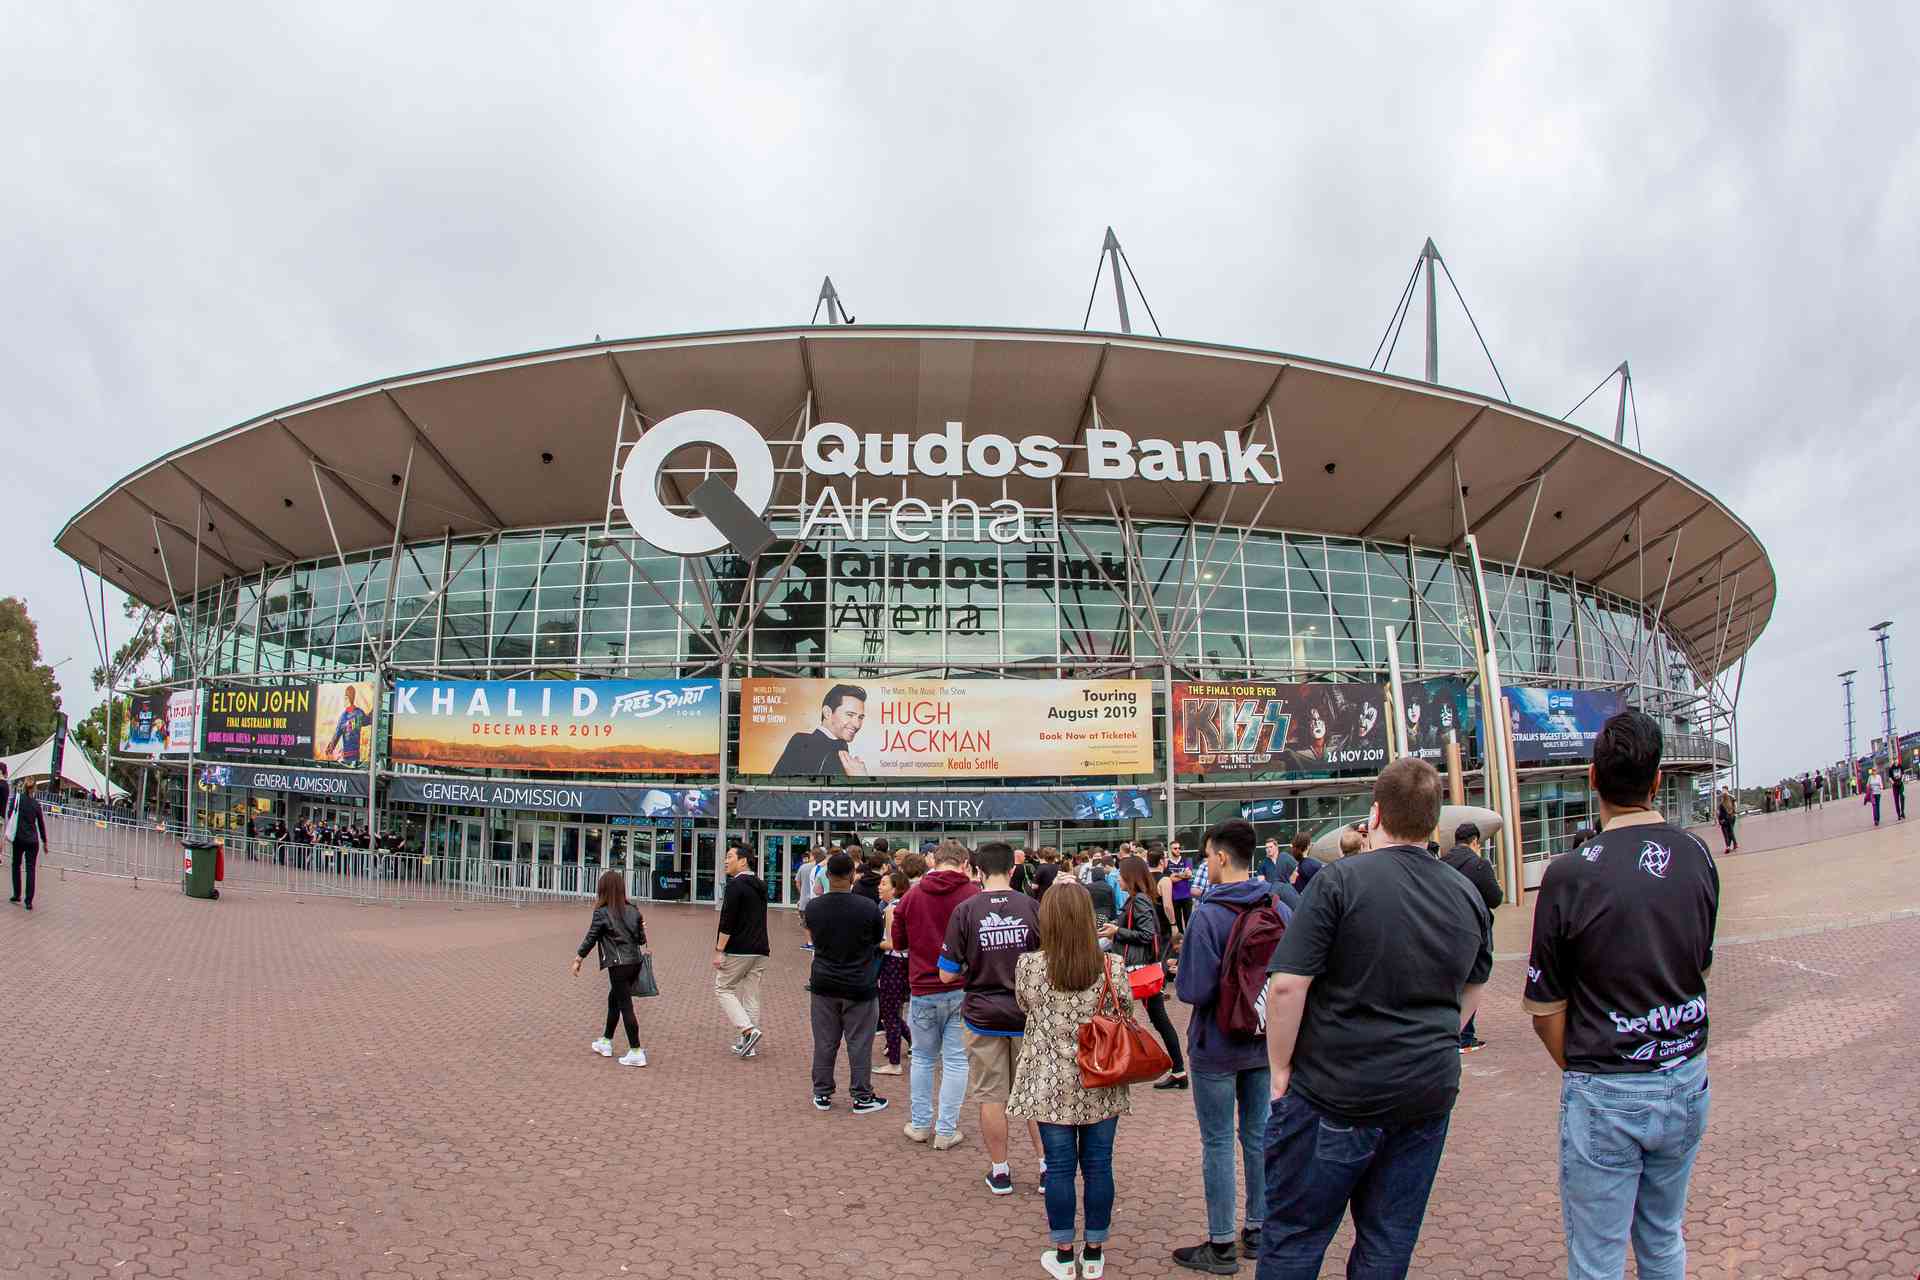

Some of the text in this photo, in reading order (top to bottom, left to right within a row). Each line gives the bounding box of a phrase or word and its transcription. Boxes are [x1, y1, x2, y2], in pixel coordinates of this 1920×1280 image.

[801, 421, 1278, 485] Qudos Bank
[797, 485, 1033, 543] Arena
[1082, 688, 1137, 704] Touring
[1188, 685, 1277, 697] THE FINAL TOUR EVER
[211, 689, 310, 713] ELTON JOHN
[395, 686, 599, 718] KHALID
[610, 690, 653, 718] FREE
[752, 704, 768, 714] WITH
[240, 716, 272, 729] AUSTRALIAN
[272, 716, 288, 729] TOUR
[880, 701, 951, 725] HUGH
[1047, 706, 1137, 722] August 2019
[472, 723, 613, 737] DECEMBER 2019
[1039, 731, 1137, 740] Book Now at Ticketek
[1183, 698, 1292, 754] KISS
[256, 732, 280, 746] JANUARY
[880, 729, 991, 753] JACKMAN
[947, 757, 972, 769] Keala
[974, 757, 999, 770] Settle
[1230, 754, 1247, 764] THE
[1327, 749, 1384, 763] 26 NOV 2019
[253, 773, 348, 794] GENERAL ADMISSION
[422, 783, 583, 808] GENERAL ADMISSION
[807, 799, 984, 818] PREMIUM ENTRY
[979, 928, 1029, 947] SYDNEY
[1609, 996, 1706, 1034] betway
